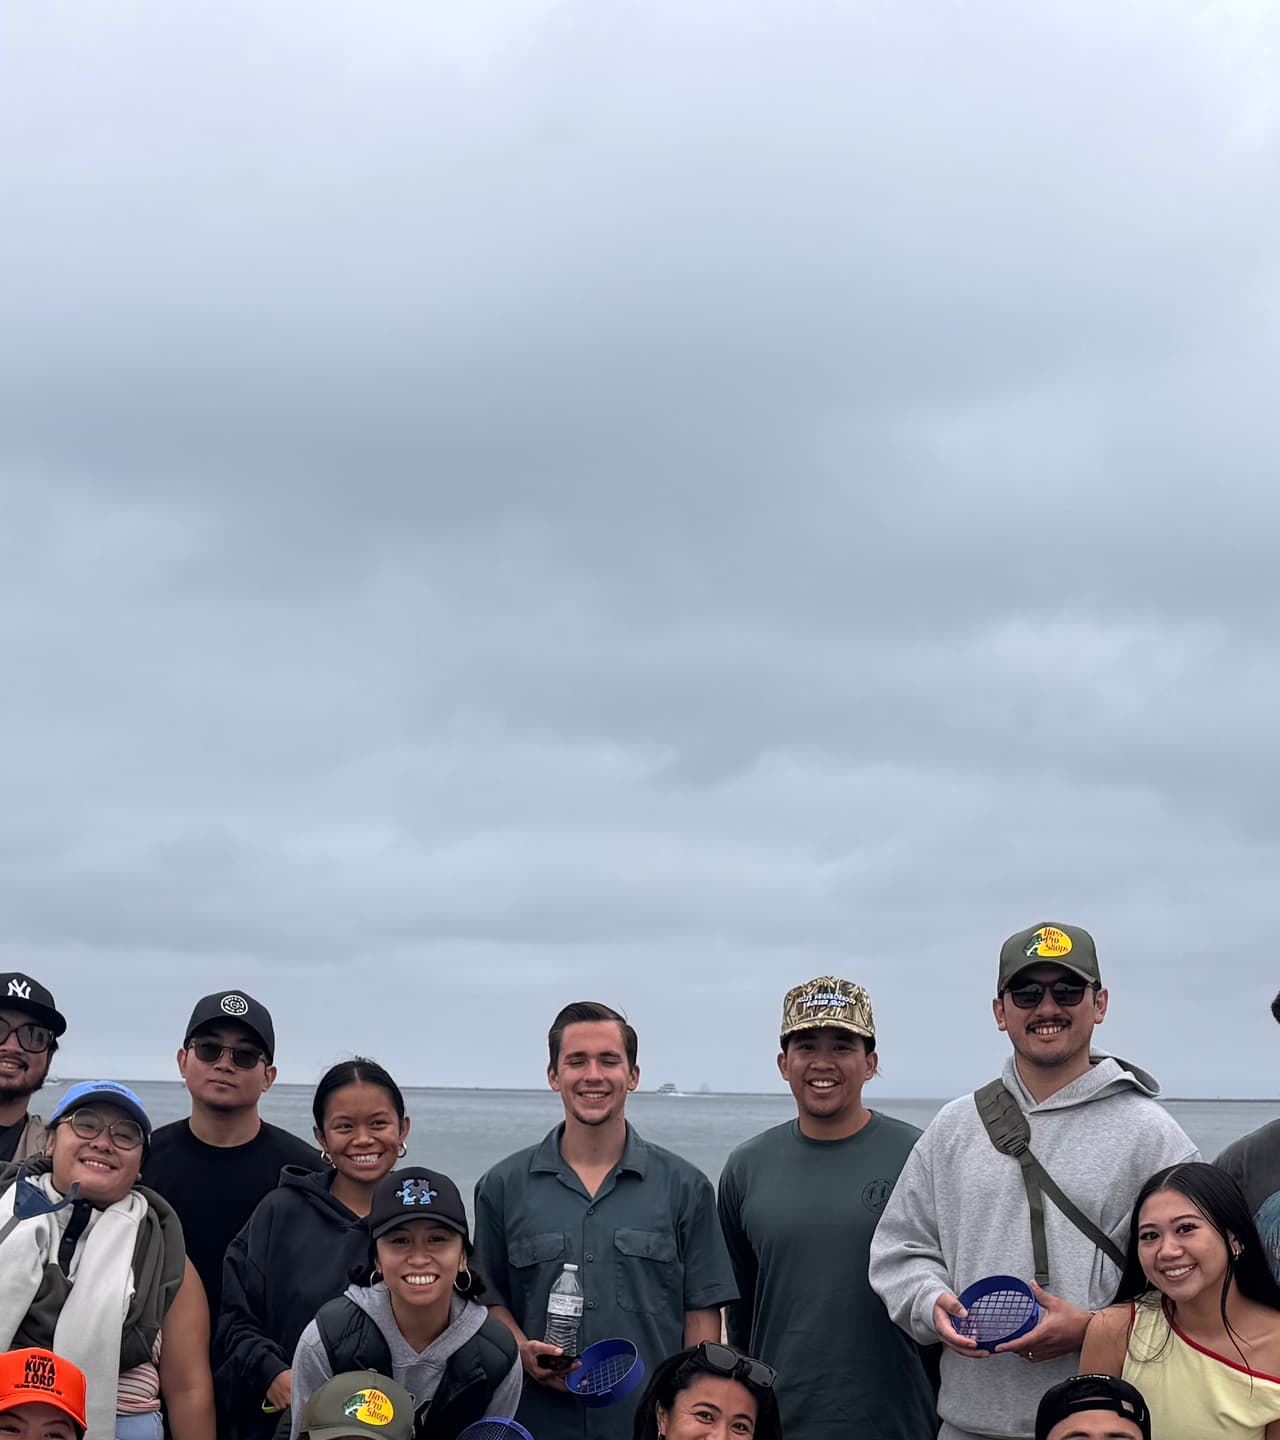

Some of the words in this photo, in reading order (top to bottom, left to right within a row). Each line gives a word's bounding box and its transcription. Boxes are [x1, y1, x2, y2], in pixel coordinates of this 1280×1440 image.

[7, 979, 31, 1000] NY
[24, 1358, 56, 1377] KUYA
[24, 1372, 55, 1387] LORD
